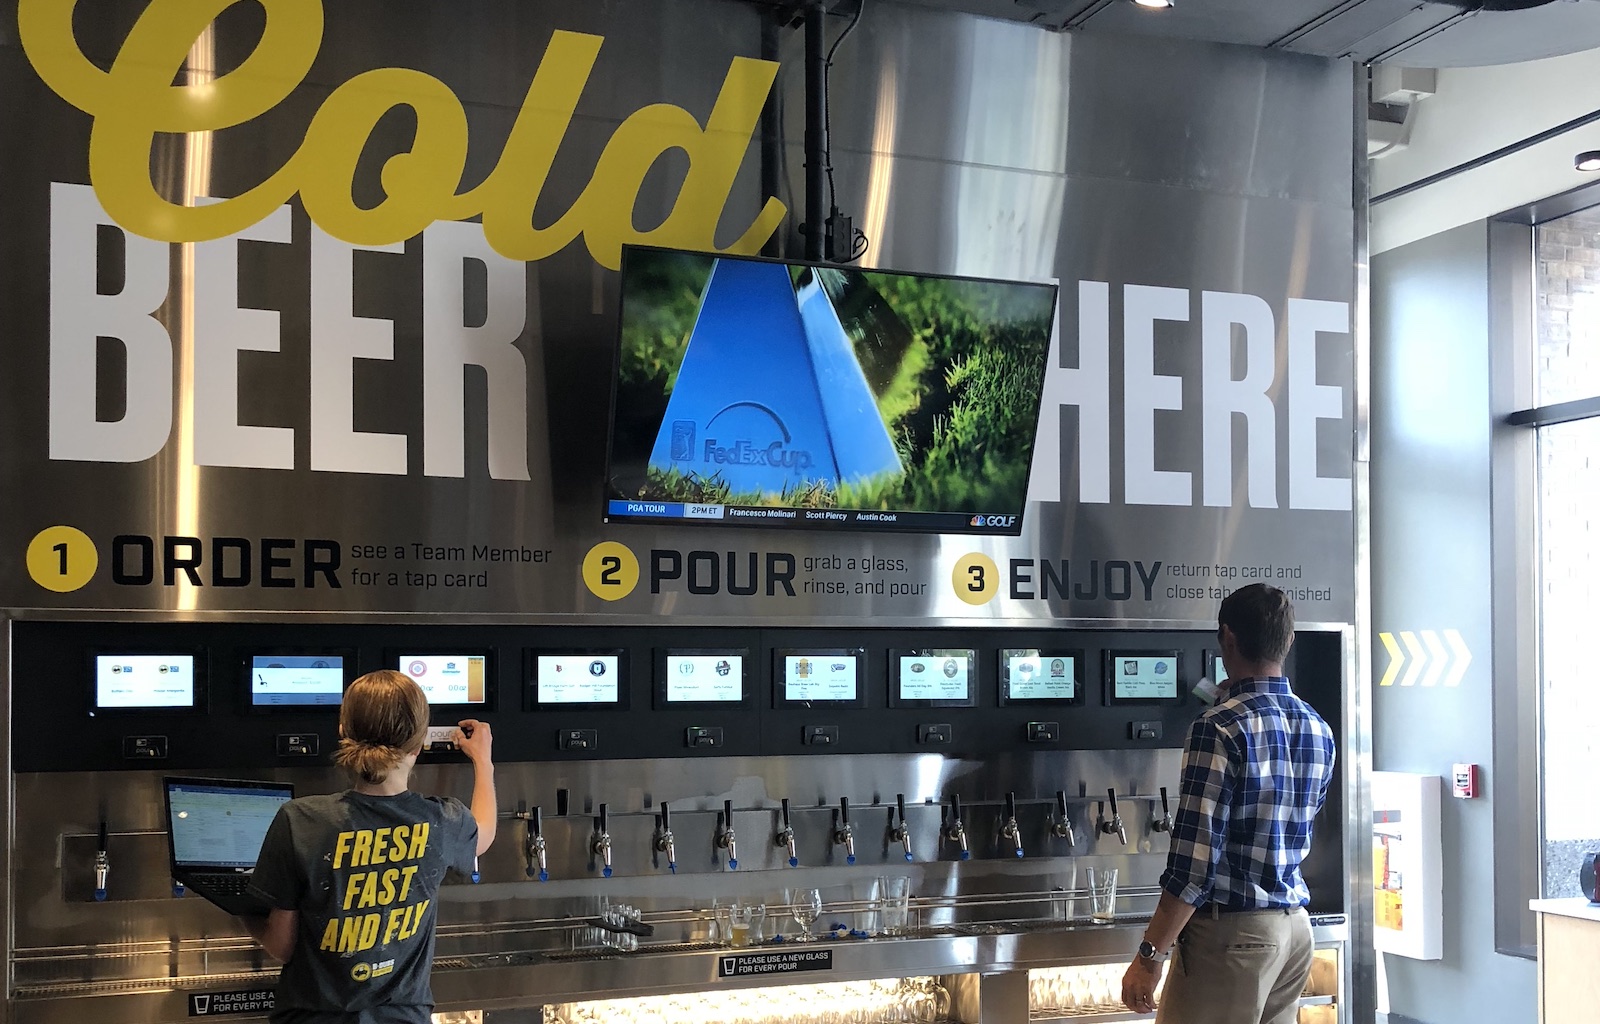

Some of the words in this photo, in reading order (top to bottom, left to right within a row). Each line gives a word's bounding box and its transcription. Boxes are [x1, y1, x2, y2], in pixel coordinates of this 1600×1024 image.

[17, 0, 787, 271] Cold
[48, 181, 531, 482] BEER
[1029, 276, 1353, 512] HERE
[627, 503, 645, 512] PGA
[645, 504, 666, 513] TOUR
[691, 506, 708, 514] 2PM
[709, 507, 718, 515] ET
[729, 508, 766, 517] Francesco
[767, 509, 797, 518] Molinari
[805, 511, 825, 519] Scott
[825, 511, 848, 521] Piercy
[856, 512, 878, 521] Austin
[879, 513, 897, 522] Cook
[986, 515, 1016, 527] GOLF
[52, 543, 68, 576] 1
[111, 534, 342, 590] ORDER
[351, 545, 387, 559] see
[394, 545, 405, 560] a
[411, 543, 466, 561] Team
[472, 545, 553, 563] Member
[600, 556, 621, 585] 2
[650, 549, 797, 597] POUR
[803, 554, 842, 573] grab
[847, 558, 856, 570] a
[861, 555, 908, 573] glass,
[1166, 563, 1210, 577] return
[1214, 564, 1237, 580] tap
[1241, 564, 1272, 578] card
[1276, 565, 1302, 579] and
[351, 568, 381, 586] for
[387, 571, 398, 586] a
[405, 570, 437, 590] tap
[444, 570, 488, 588] card
[803, 578, 849, 596] rinse,
[855, 579, 885, 594] and
[890, 583, 927, 598] pour
[967, 565, 985, 592] 3
[1009, 558, 1163, 601] ENJOY
[1166, 584, 1204, 599] close
[1208, 585, 1231, 599] tab
[1279, 586, 1331, 601] nished
[332, 822, 430, 869] FRESH
[342, 865, 419, 911] FAST
[320, 912, 382, 953] AND
[382, 899, 431, 945] FLY
[739, 956, 766, 965] PLEASE
[766, 954, 781, 963] USE
[781, 954, 788, 962] A
[788, 953, 805, 961] NEW
[806, 952, 829, 960] GLASS
[739, 965, 753, 973] FOR
[754, 963, 777, 972] EVERY
[777, 962, 798, 971] POUR
[213, 993, 248, 1003] PLEASE
[249, 992, 267, 1000] USE
[268, 991, 275, 999] A
[213, 1003, 231, 1012] FOR
[233, 1001, 261, 1011] EVERY
